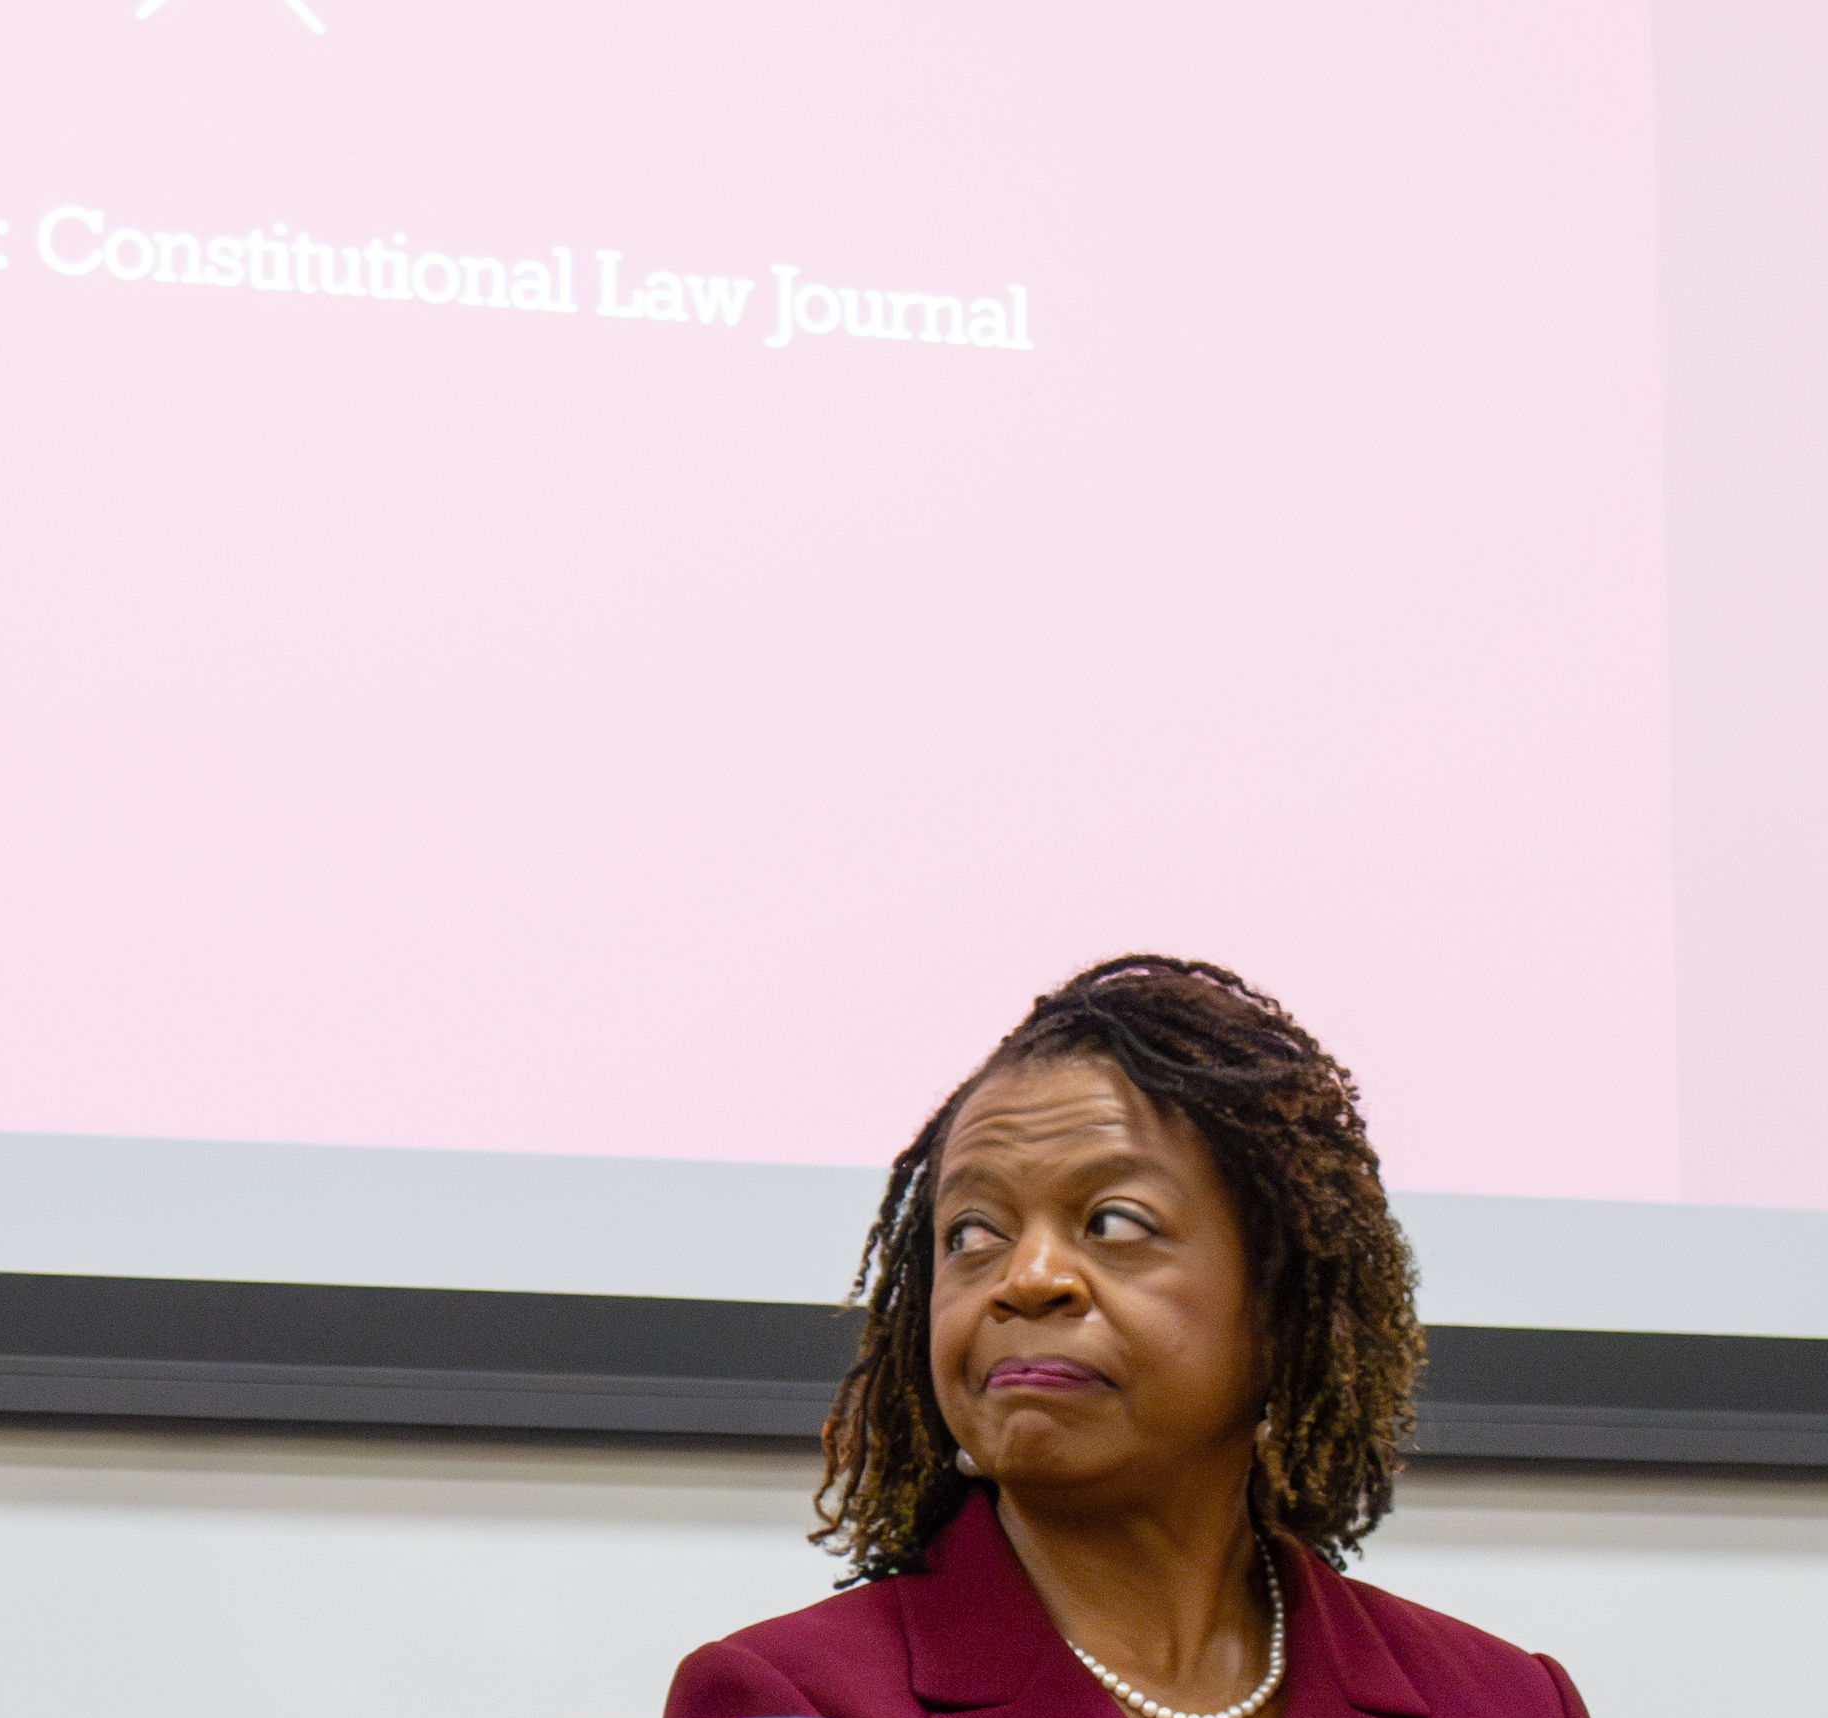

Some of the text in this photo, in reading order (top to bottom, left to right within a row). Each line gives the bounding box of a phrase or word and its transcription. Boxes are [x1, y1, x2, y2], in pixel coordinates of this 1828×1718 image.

[36, 204, 579, 314] Constitutional
[595, 249, 755, 327] Law
[764, 263, 1034, 350] Journal
